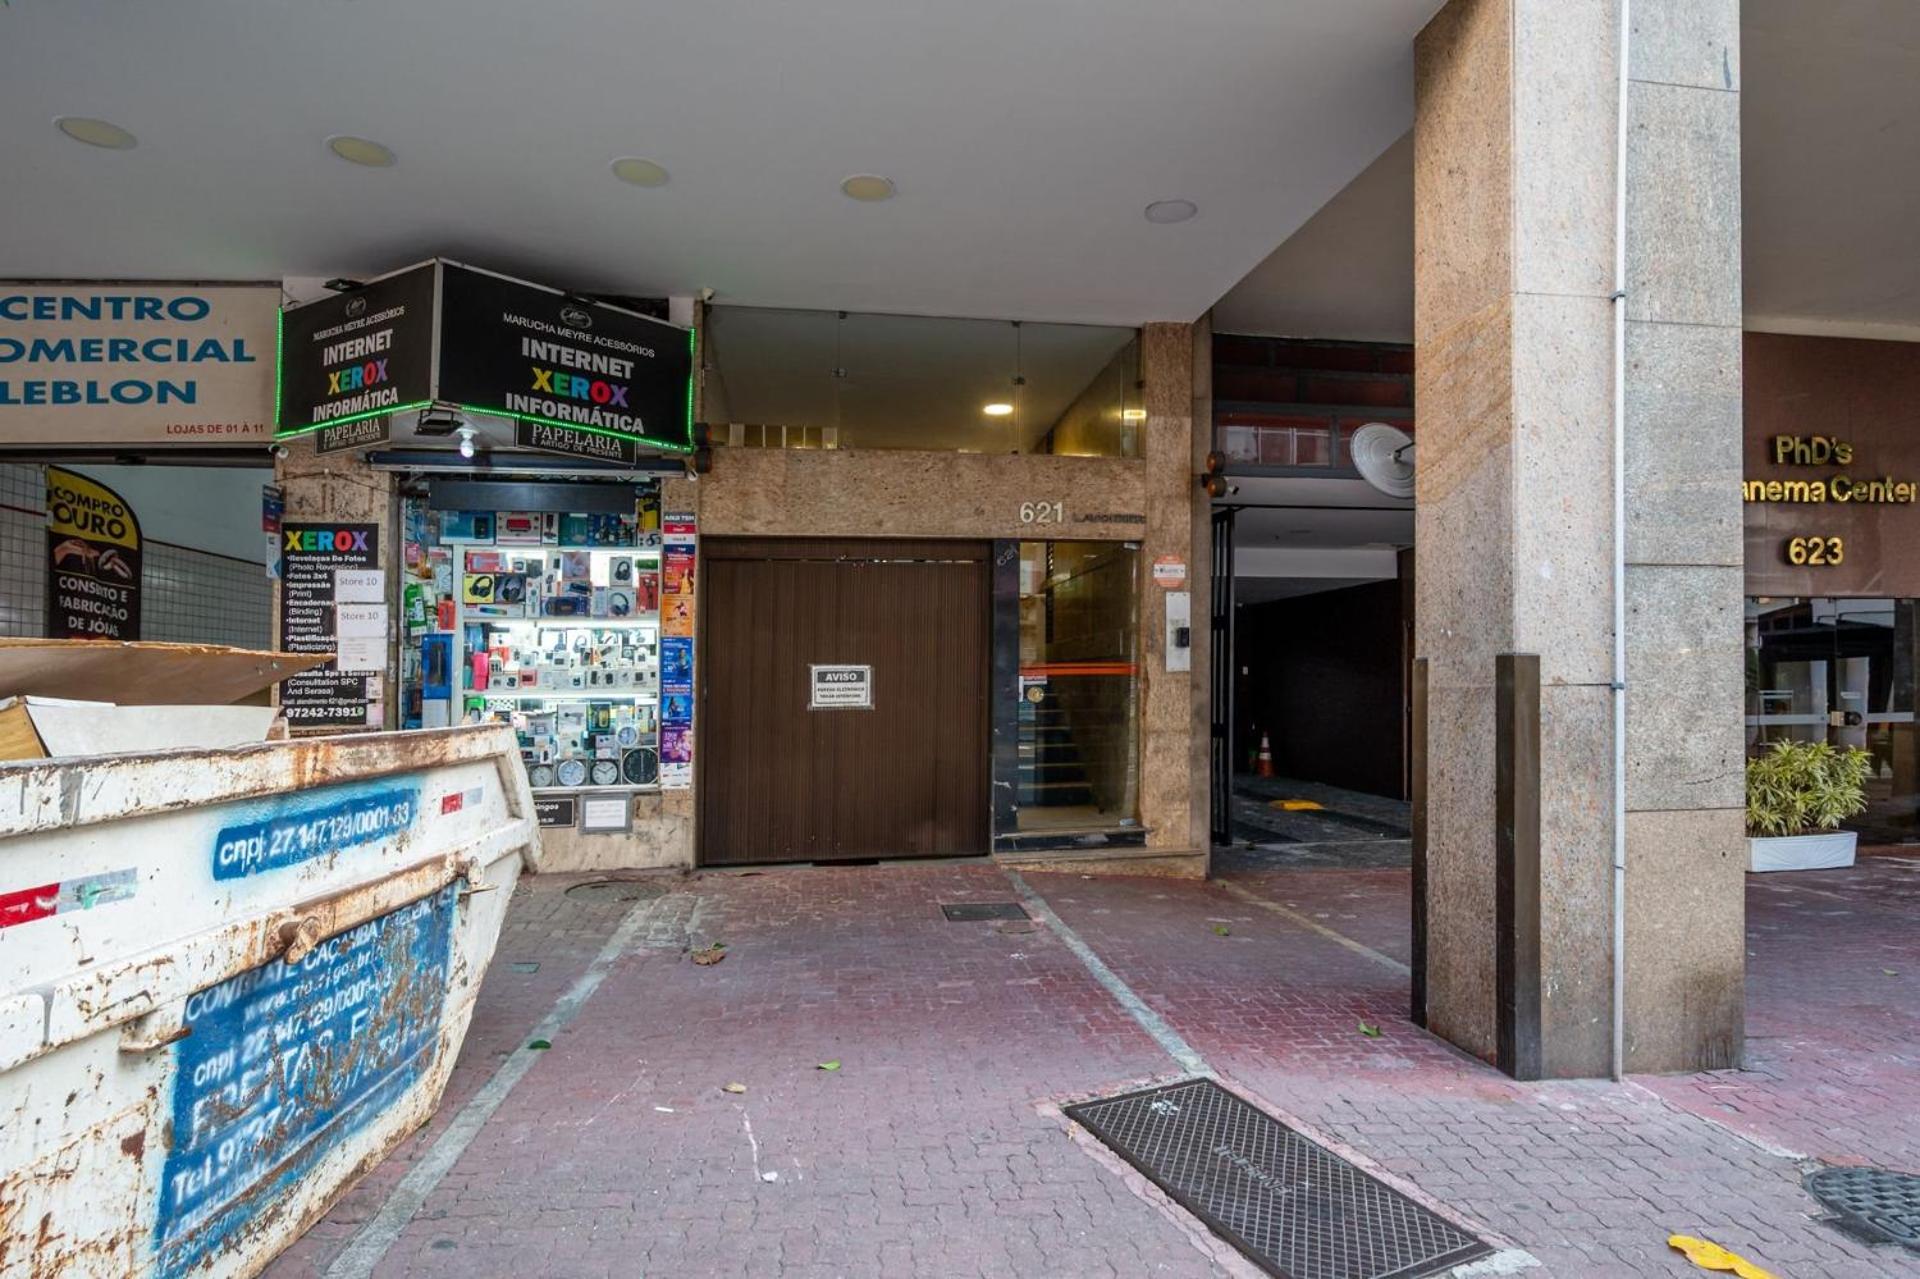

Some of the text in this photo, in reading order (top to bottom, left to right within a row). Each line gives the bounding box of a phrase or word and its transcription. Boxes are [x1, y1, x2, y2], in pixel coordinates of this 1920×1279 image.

[0, 296, 210, 321] CENTRO
[503, 312, 556, 334] MARUCHA
[557, 326, 592, 343] MEYRE
[324, 328, 393, 367] INTERNET
[521, 336, 635, 380] INTERNET
[328, 358, 389, 396] XEROX
[531, 366, 629, 409] XEROX
[0, 380, 197, 404] LEBLON
[313, 386, 399, 423] INFORMÁTICA
[506, 392, 645, 434] INFORMÁTICA
[166, 424, 204, 434] LOJAS
[207, 424, 223, 433] DE
[226, 424, 238, 433] 01
[254, 423, 264, 433] 11
[324, 417, 381, 443] PAPELARIA
[532, 423, 622, 452] PAPELARIA
[541, 440, 569, 450] ARTIGO
[573, 444, 582, 452] DE
[586, 446, 622, 459] PRESENTE
[1776, 435, 1853, 465] PhD's
[54, 486, 124, 518] COMPRO
[1831, 475, 1918, 503] Center
[53, 502, 127, 540] OURO
[1019, 502, 1063, 524] 621
[284, 530, 369, 552] XEROX
[1788, 537, 1844, 566] 623
[340, 577, 378, 586] Store 10
[121, 590, 128, 602] E
[68, 616, 84, 630] DE
[341, 612, 379, 621] Store 10
[825, 672, 858, 682] AVISO
[287, 687, 303, 695] And
[286, 707, 358, 718] 97242-7391
